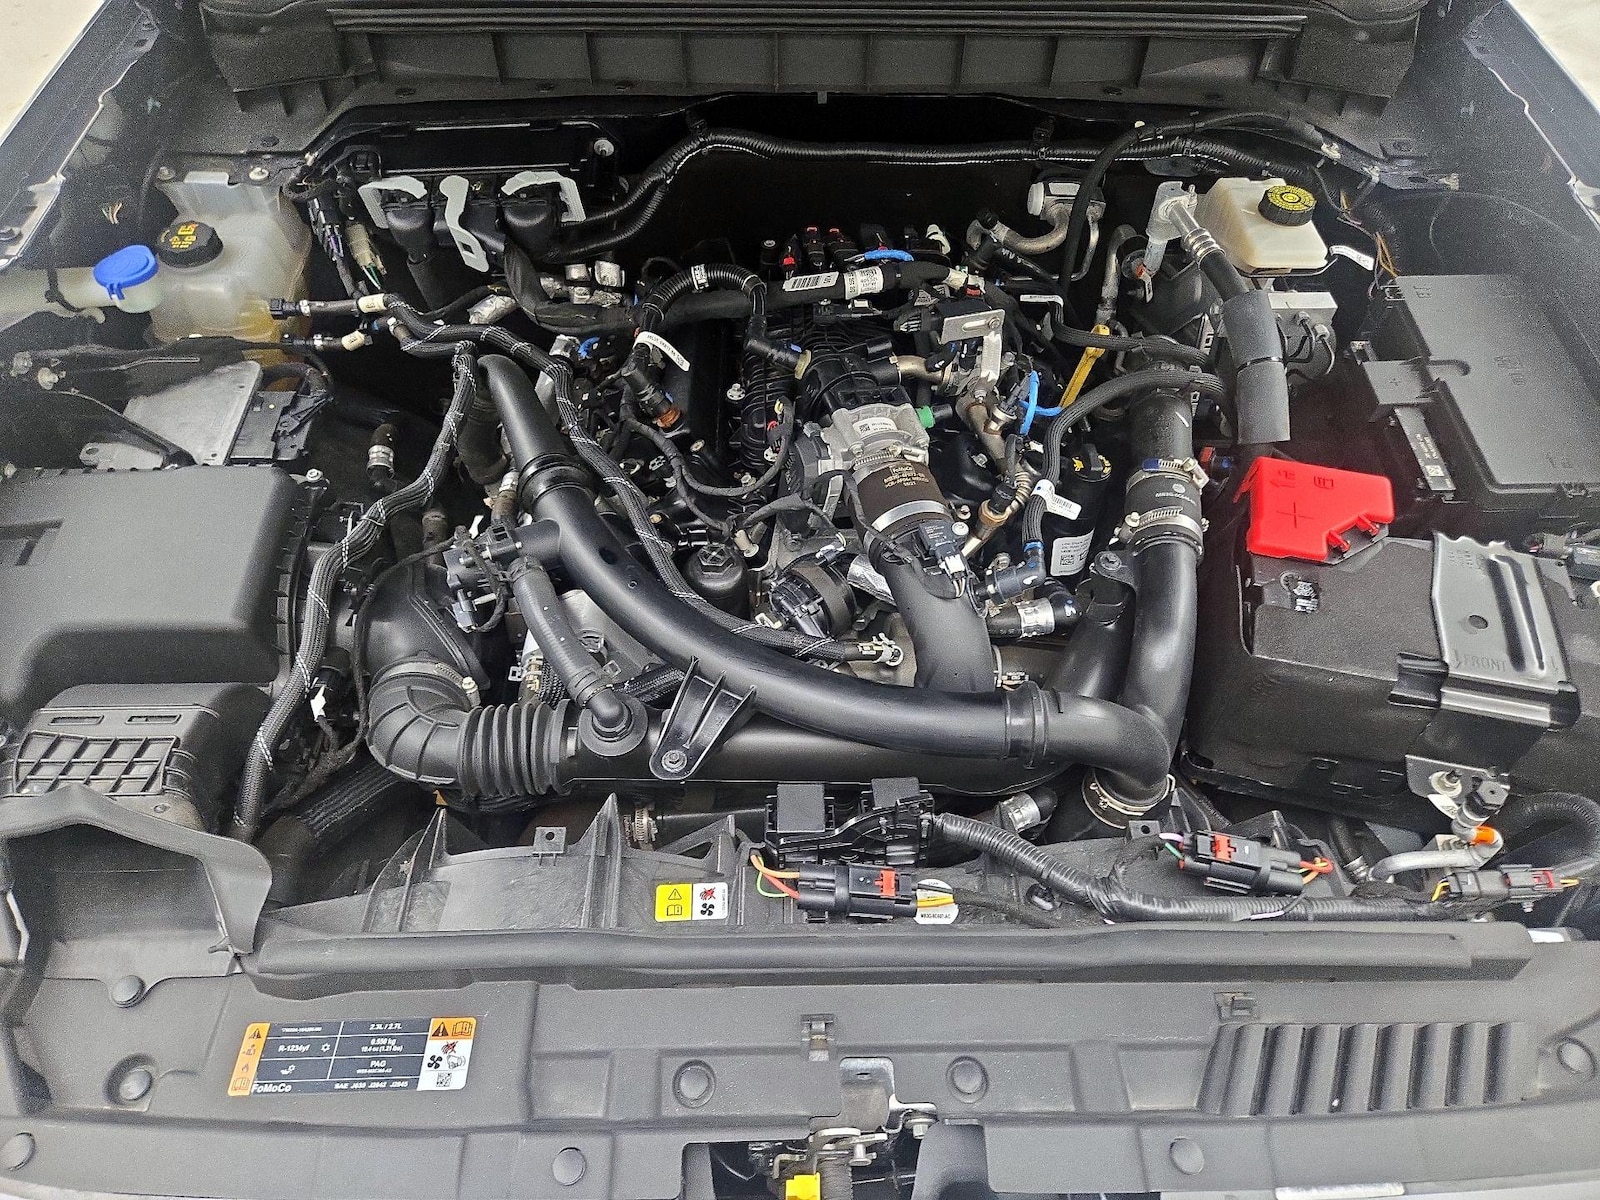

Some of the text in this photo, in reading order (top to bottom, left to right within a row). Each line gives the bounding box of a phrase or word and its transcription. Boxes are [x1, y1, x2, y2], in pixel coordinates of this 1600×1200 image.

[1463, 654, 1506, 673] FRONT
[388, 1037, 397, 1046] kg
[278, 1043, 311, 1053] R-1234yf
[370, 1060, 386, 1068] PAG
[251, 1083, 292, 1093] FoMoCo
